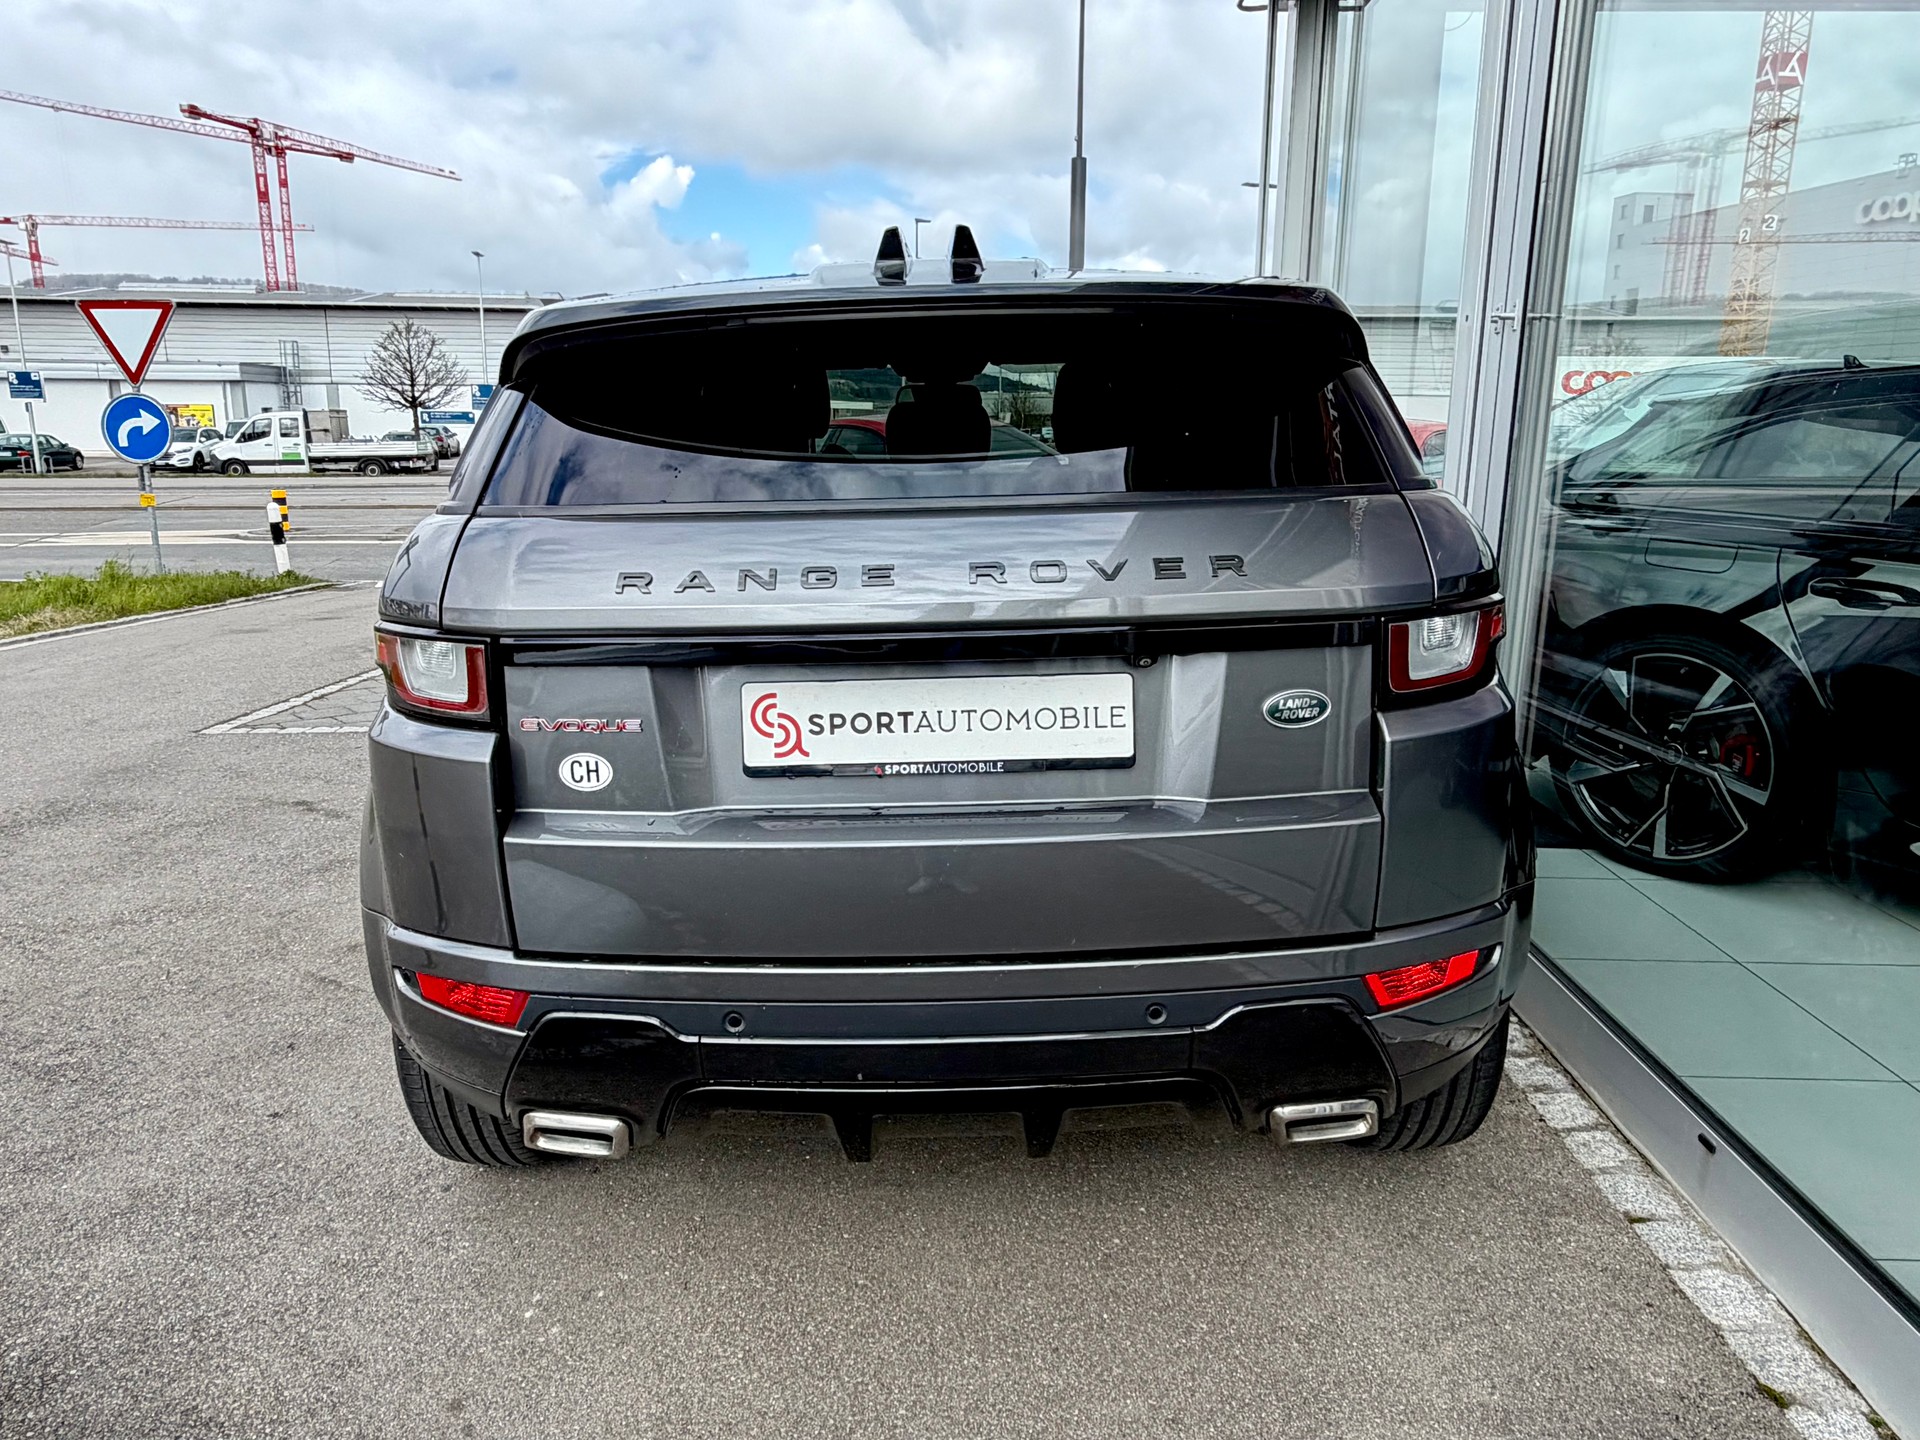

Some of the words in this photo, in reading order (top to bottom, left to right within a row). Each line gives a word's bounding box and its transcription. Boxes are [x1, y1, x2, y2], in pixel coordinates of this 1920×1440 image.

[1764, 215, 1776, 229] 2
[1740, 228, 1749, 242] 2
[614, 562, 896, 595] RANGE
[968, 554, 1249, 585] ROVER
[1278, 697, 1311, 710] LAND
[808, 705, 1127, 737] SPORTAUTOMOBILE
[1280, 707, 1320, 720] ROVER
[520, 717, 643, 735] EVOQUE
[569, 759, 601, 784] CH
[884, 761, 1006, 776] SPORTAUTOMOBILE
